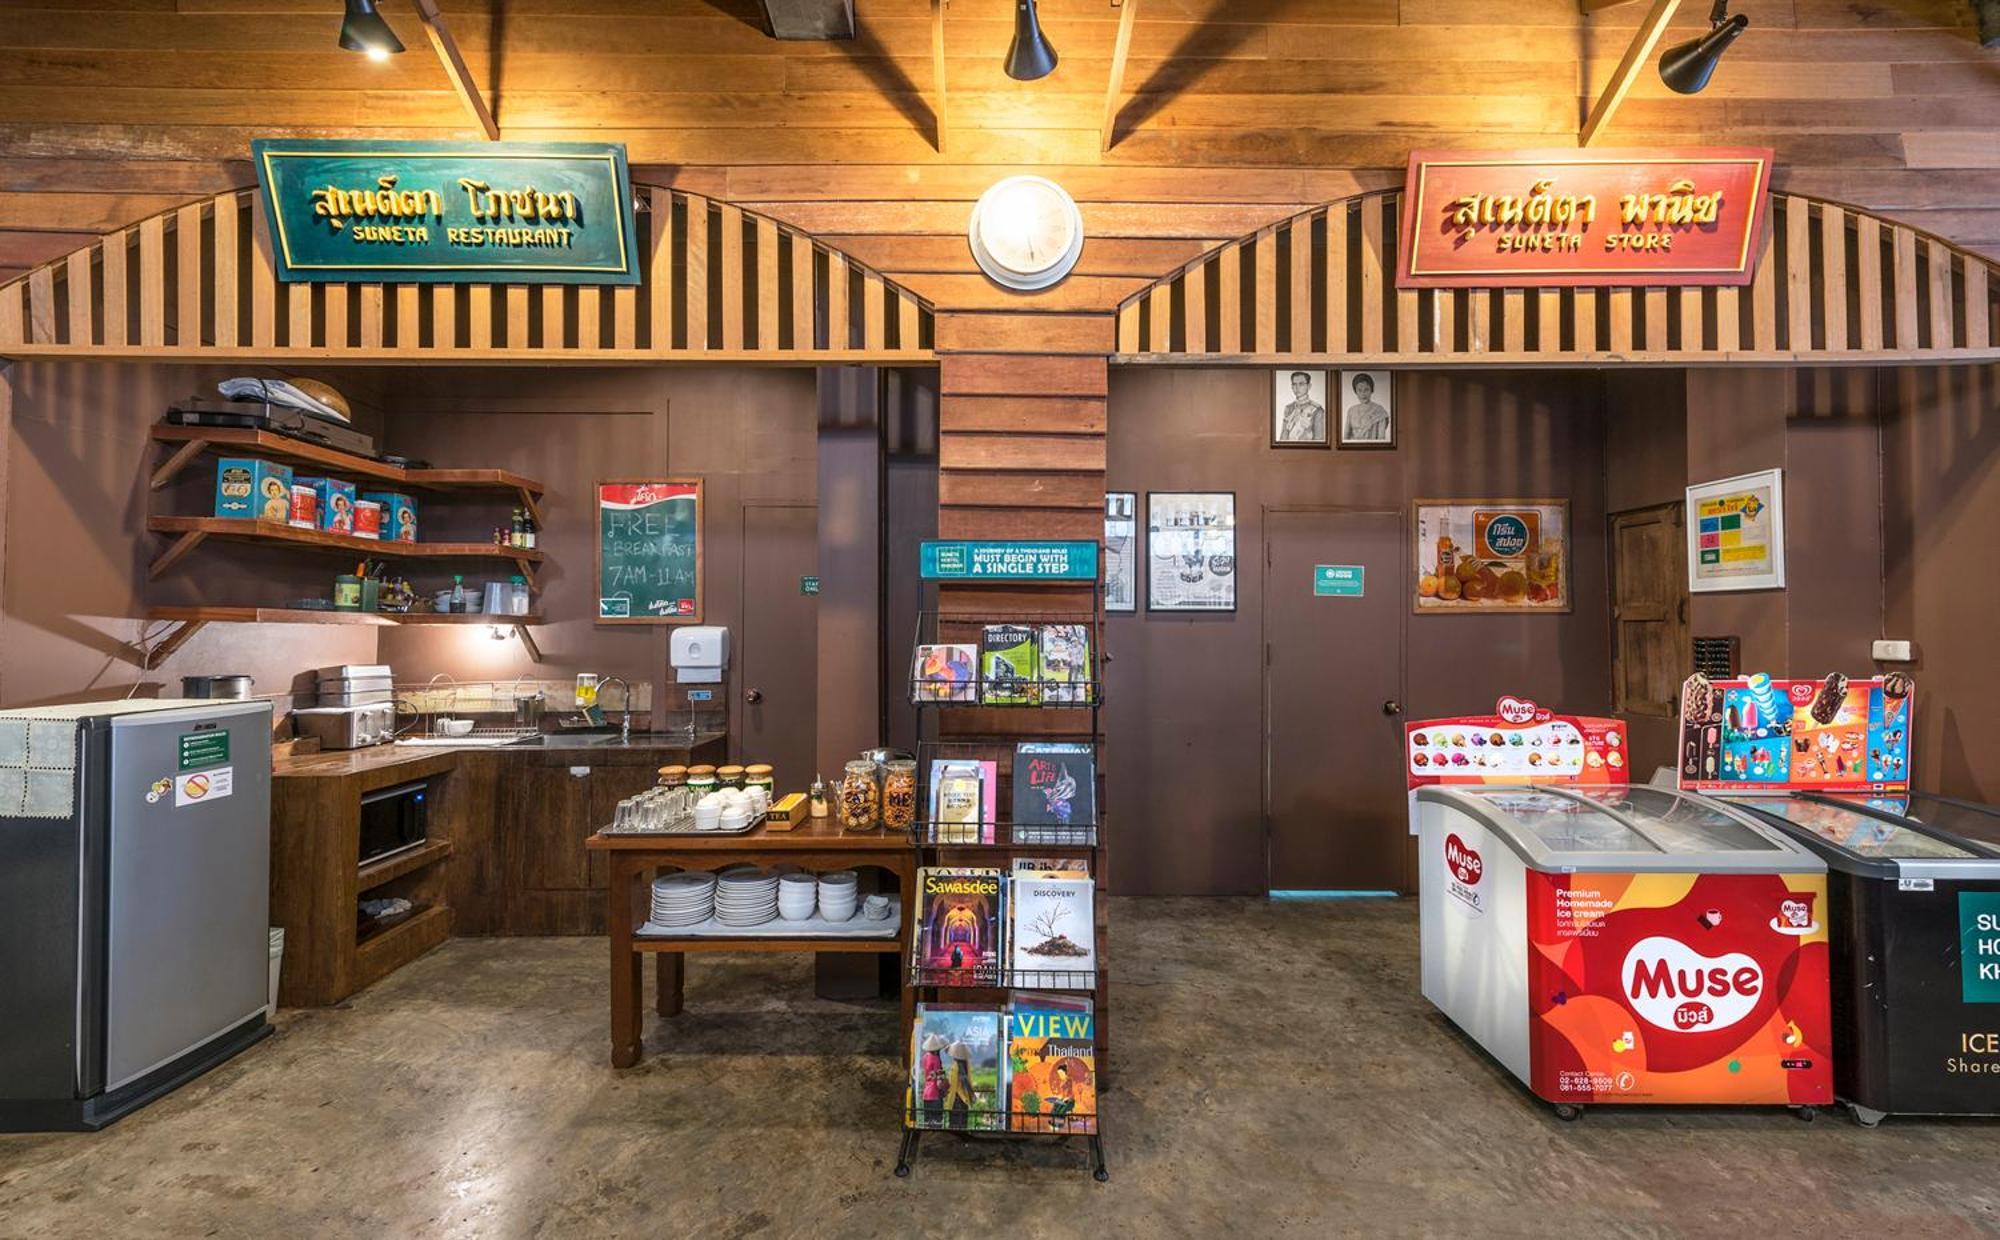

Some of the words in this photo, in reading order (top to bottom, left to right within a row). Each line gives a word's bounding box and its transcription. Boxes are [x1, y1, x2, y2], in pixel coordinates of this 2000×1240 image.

[353, 226, 428, 244] SUNETA
[448, 227, 570, 248] RESTAURANT
[1498, 233, 1582, 250] SUNETA
[1605, 233, 1672, 250] STORE
[608, 512, 681, 538] FREE
[974, 554, 1001, 563] MUST
[1004, 554, 1037, 563] BEGIN
[1039, 554, 1068, 563] WITH
[973, 563, 983, 574] A
[987, 563, 1034, 574] SINGLE
[1037, 563, 1069, 574] STEP
[987, 633, 1027, 643] DIRECTORY
[1502, 704, 1535, 715] Muse
[769, 812, 787, 820] TEA
[1447, 842, 1481, 874] Muse
[926, 877, 998, 895] Sawasdee
[1556, 889, 1601, 898] Premium
[1556, 899, 1614, 908] Homemade
[1783, 904, 1806, 912] Muse
[1556, 909, 1572, 918] Ice
[1573, 910, 1605, 918] cream
[1630, 958, 1760, 1000] Muse
[1018, 1015, 1090, 1038] VIEW
[1961, 1033, 1999, 1053] ICE
[1048, 1044, 1094, 1057] Thailand
[1946, 1056, 2000, 1074] Share
